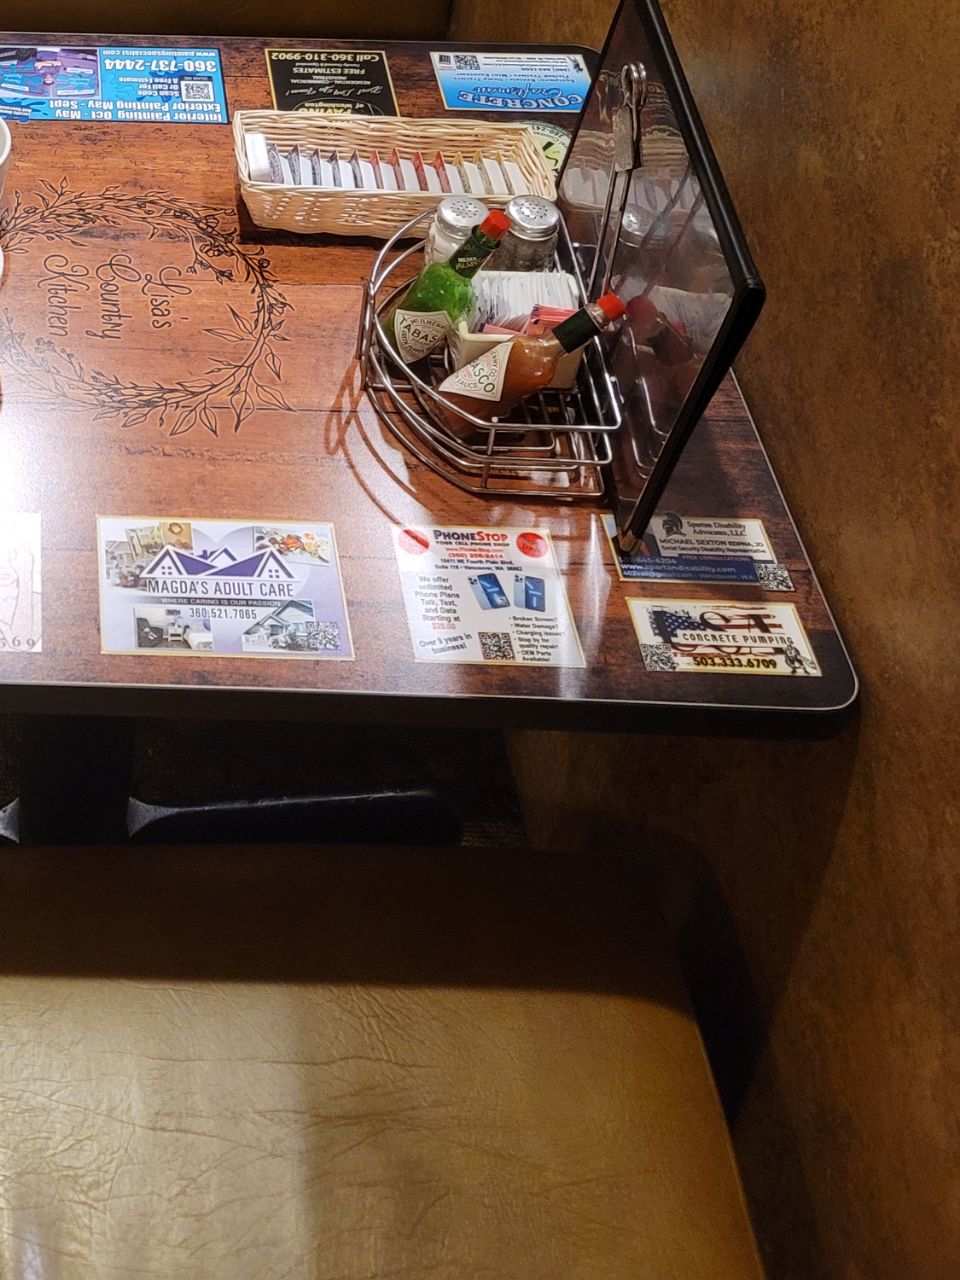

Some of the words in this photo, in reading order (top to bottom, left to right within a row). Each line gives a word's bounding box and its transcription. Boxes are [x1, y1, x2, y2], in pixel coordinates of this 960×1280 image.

[271, 52, 354, 61] 360-310-9902
[356, 54, 380, 62] Call
[104, 58, 217, 72] 360-737-2444
[472, 83, 563, 99] Craftsman
[49, 99, 78, 109] Sept
[88, 99, 114, 110] May
[117, 100, 170, 112] Painting
[304, 101, 353, 109] Washington
[457, 91, 584, 110] CONCRETE
[172, 101, 221, 112] Exterior
[55, 109, 81, 119] May
[90, 110, 112, 119] Oct
[118, 110, 171, 121] Painting
[172, 112, 222, 122] Interior
[37, 254, 90, 337] Kitchen
[85, 254, 141, 339] Country
[142, 266, 192, 329] Lisa's
[400, 314, 439, 343] TABAS
[455, 376, 479, 389] SAUCE
[687, 521, 713, 529] Spartan
[714, 521, 746, 531] Disability
[693, 529, 730, 537] Advocates,
[147, 580, 209, 595] MAGDA'S
[213, 582, 254, 596] ADULT
[259, 583, 295, 597] CARE
[414, 590, 438, 598] Phone
[420, 598, 439, 606] Talk,
[439, 599, 458, 607] Text,
[189, 608, 257, 620] 360.521.7065
[422, 614, 451, 623] Starting
[419, 639, 436, 647] Over
[443, 635, 464, 645] years
[682, 633, 739, 643] CONCRETE
[742, 634, 794, 646] PUMPING
[431, 643, 467, 655] business!
[692, 657, 778, 669] 503.333.6709
